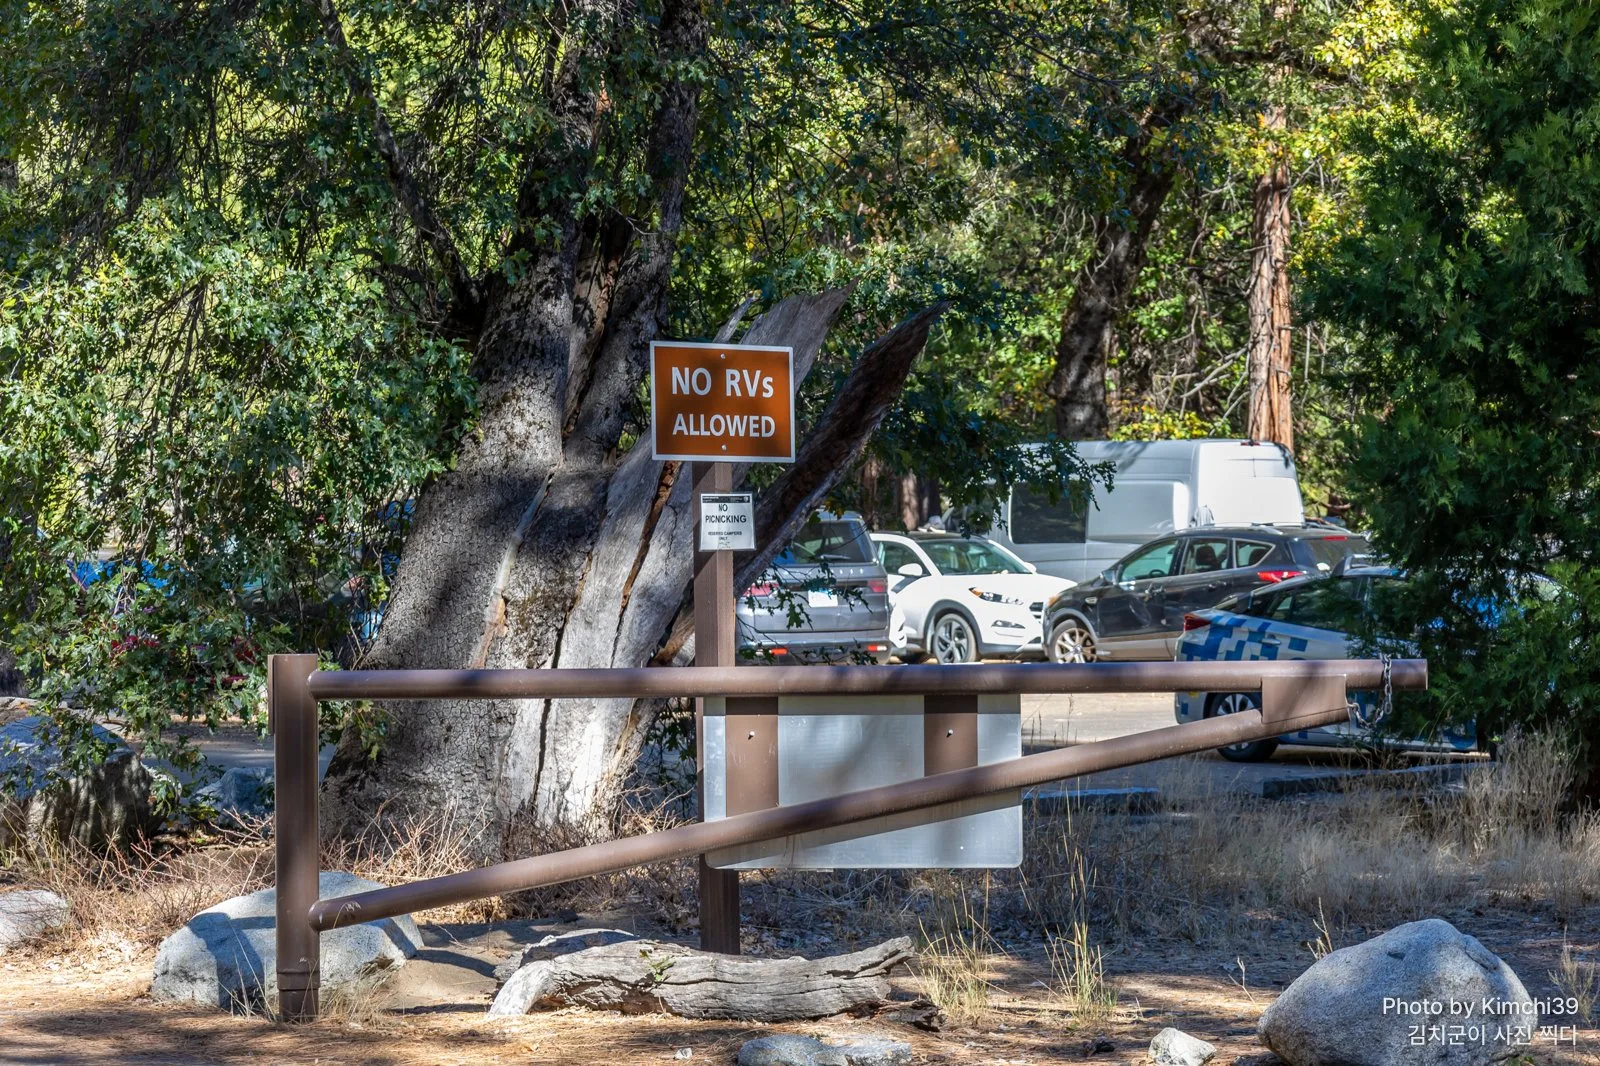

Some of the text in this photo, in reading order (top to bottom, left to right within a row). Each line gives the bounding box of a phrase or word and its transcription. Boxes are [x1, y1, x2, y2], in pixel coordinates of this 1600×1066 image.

[672, 367, 774, 398] NO RVs
[672, 413, 776, 438] ALLOWED
[718, 503, 728, 512] NO
